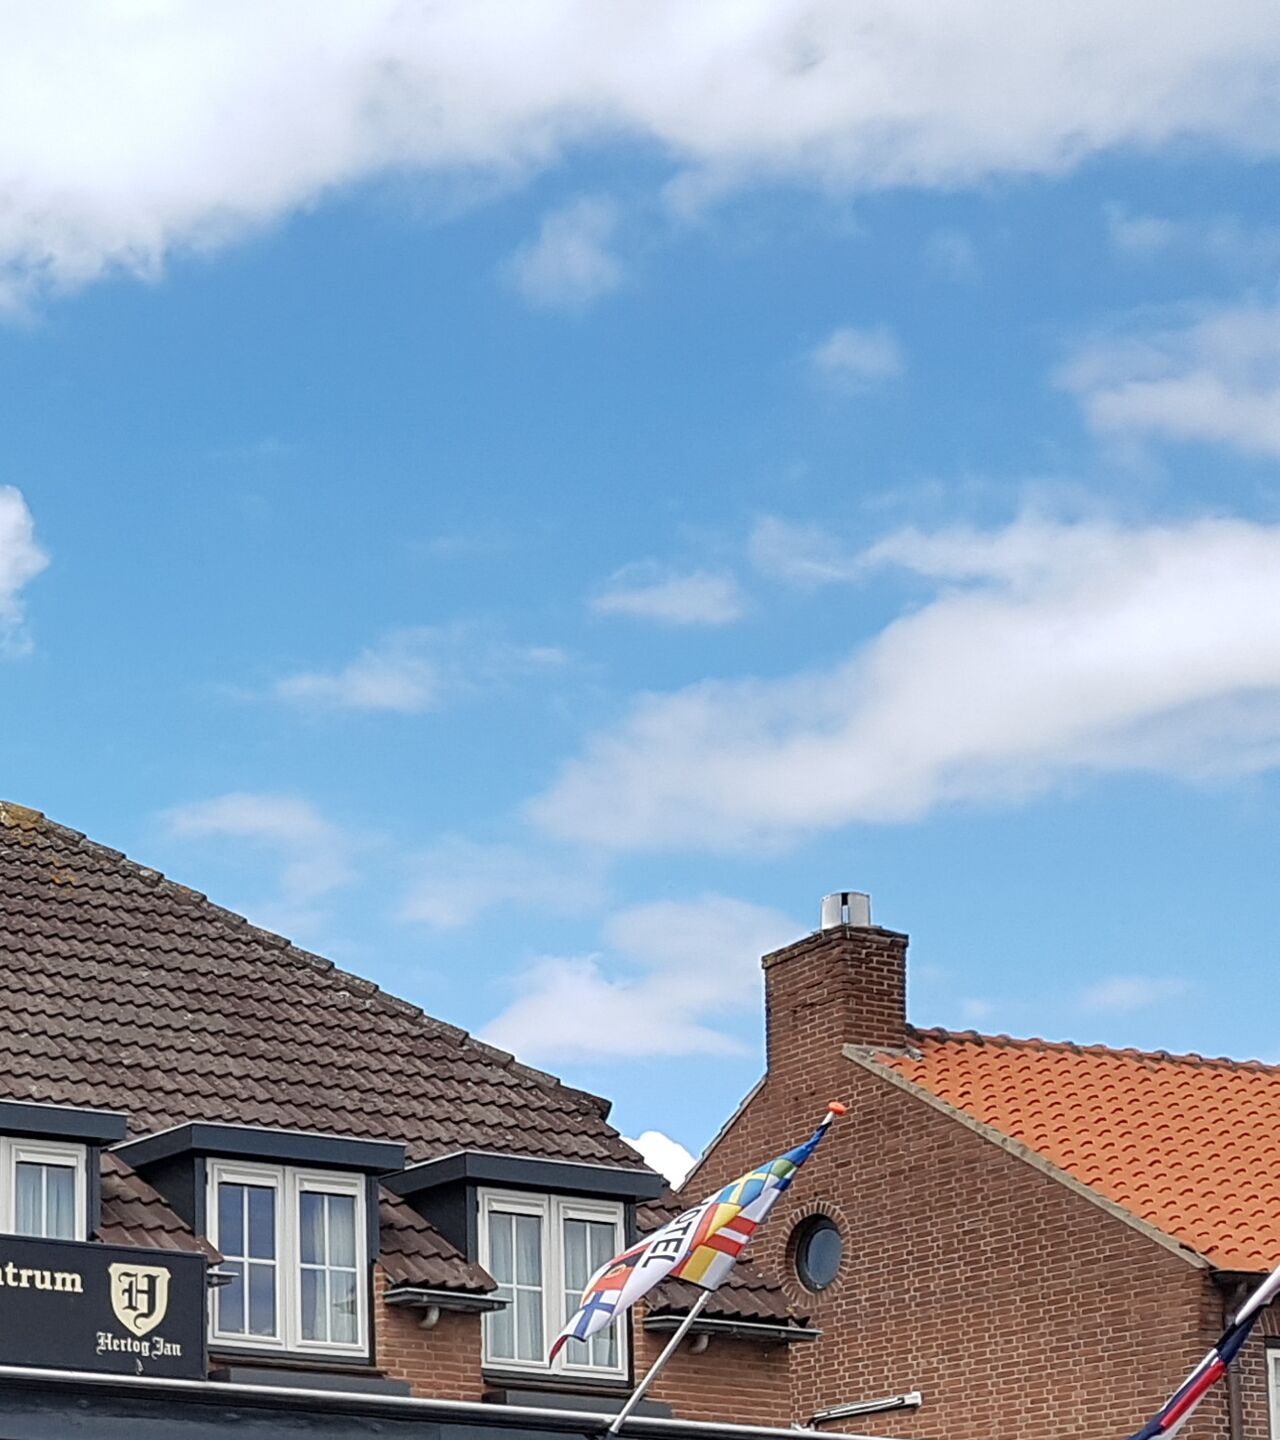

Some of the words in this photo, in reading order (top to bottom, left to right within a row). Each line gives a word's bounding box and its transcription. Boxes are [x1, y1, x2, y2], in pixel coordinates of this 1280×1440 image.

[641, 1201, 709, 1269] OTEL
[96, 1331, 151, 1357] Hertog
[151, 1336, 182, 1360] Jan
